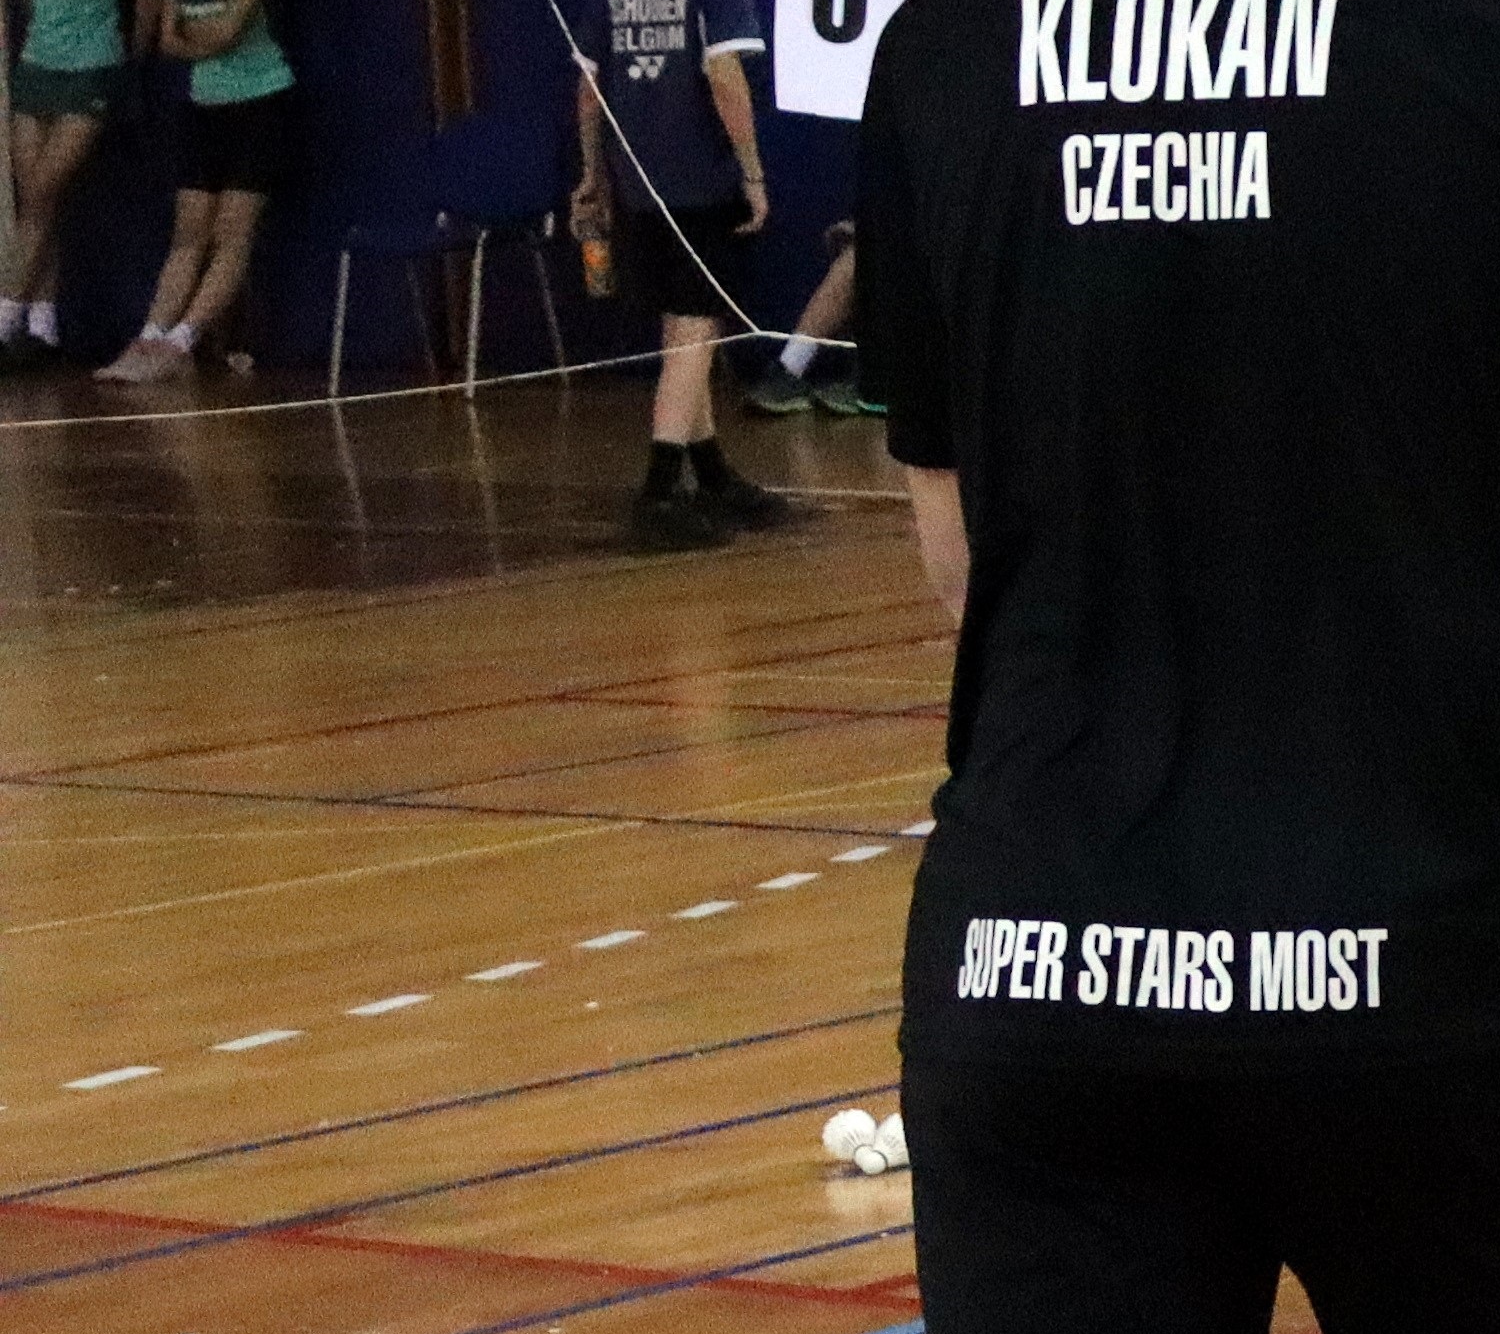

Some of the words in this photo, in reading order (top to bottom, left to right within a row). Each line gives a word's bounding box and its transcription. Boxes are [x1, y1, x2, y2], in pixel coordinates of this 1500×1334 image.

[1062, 131, 1271, 225] CZECHIA
[957, 918, 1068, 1001] SUPER
[1077, 923, 1234, 1013] STARS
[1250, 928, 1388, 1012] MOST
